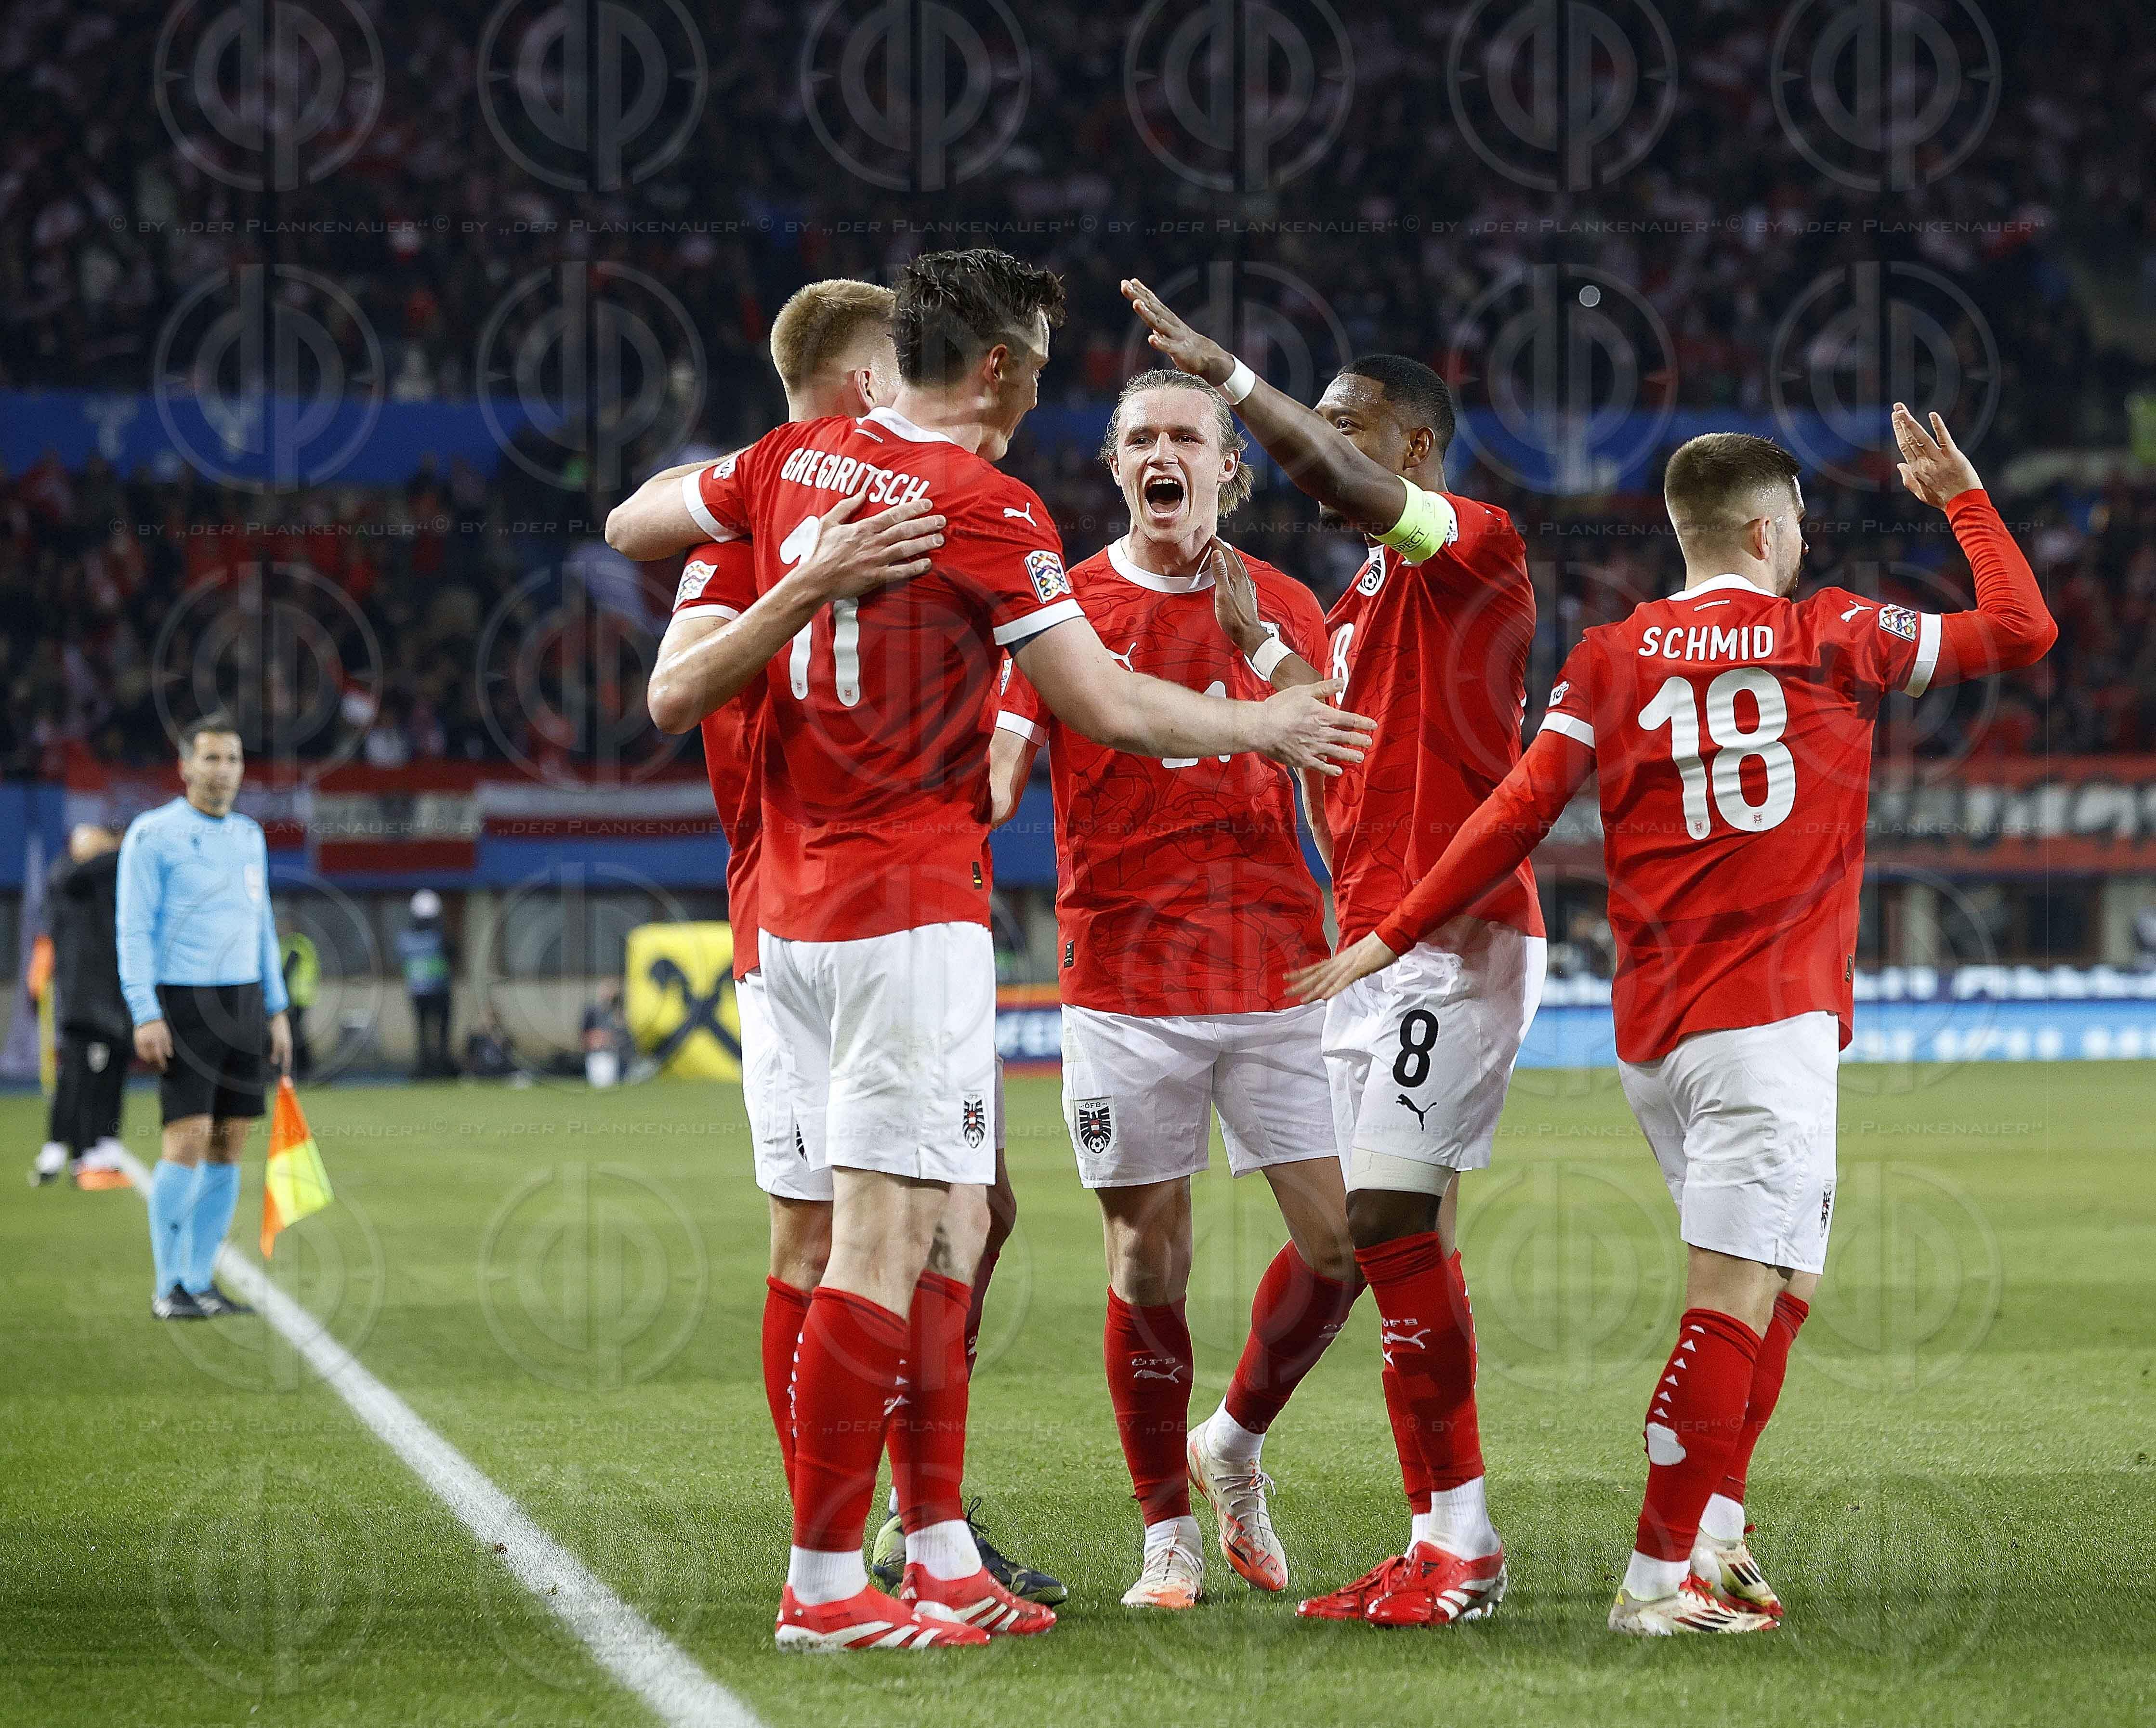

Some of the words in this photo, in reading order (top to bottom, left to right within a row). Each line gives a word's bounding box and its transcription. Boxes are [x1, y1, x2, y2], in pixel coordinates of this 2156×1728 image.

[780, 447, 930, 506] GREGORITSCH
[1638, 625, 1774, 661] SCHMID
[1638, 667, 1796, 840] 18
[1393, 1009, 1439, 1087] 8
